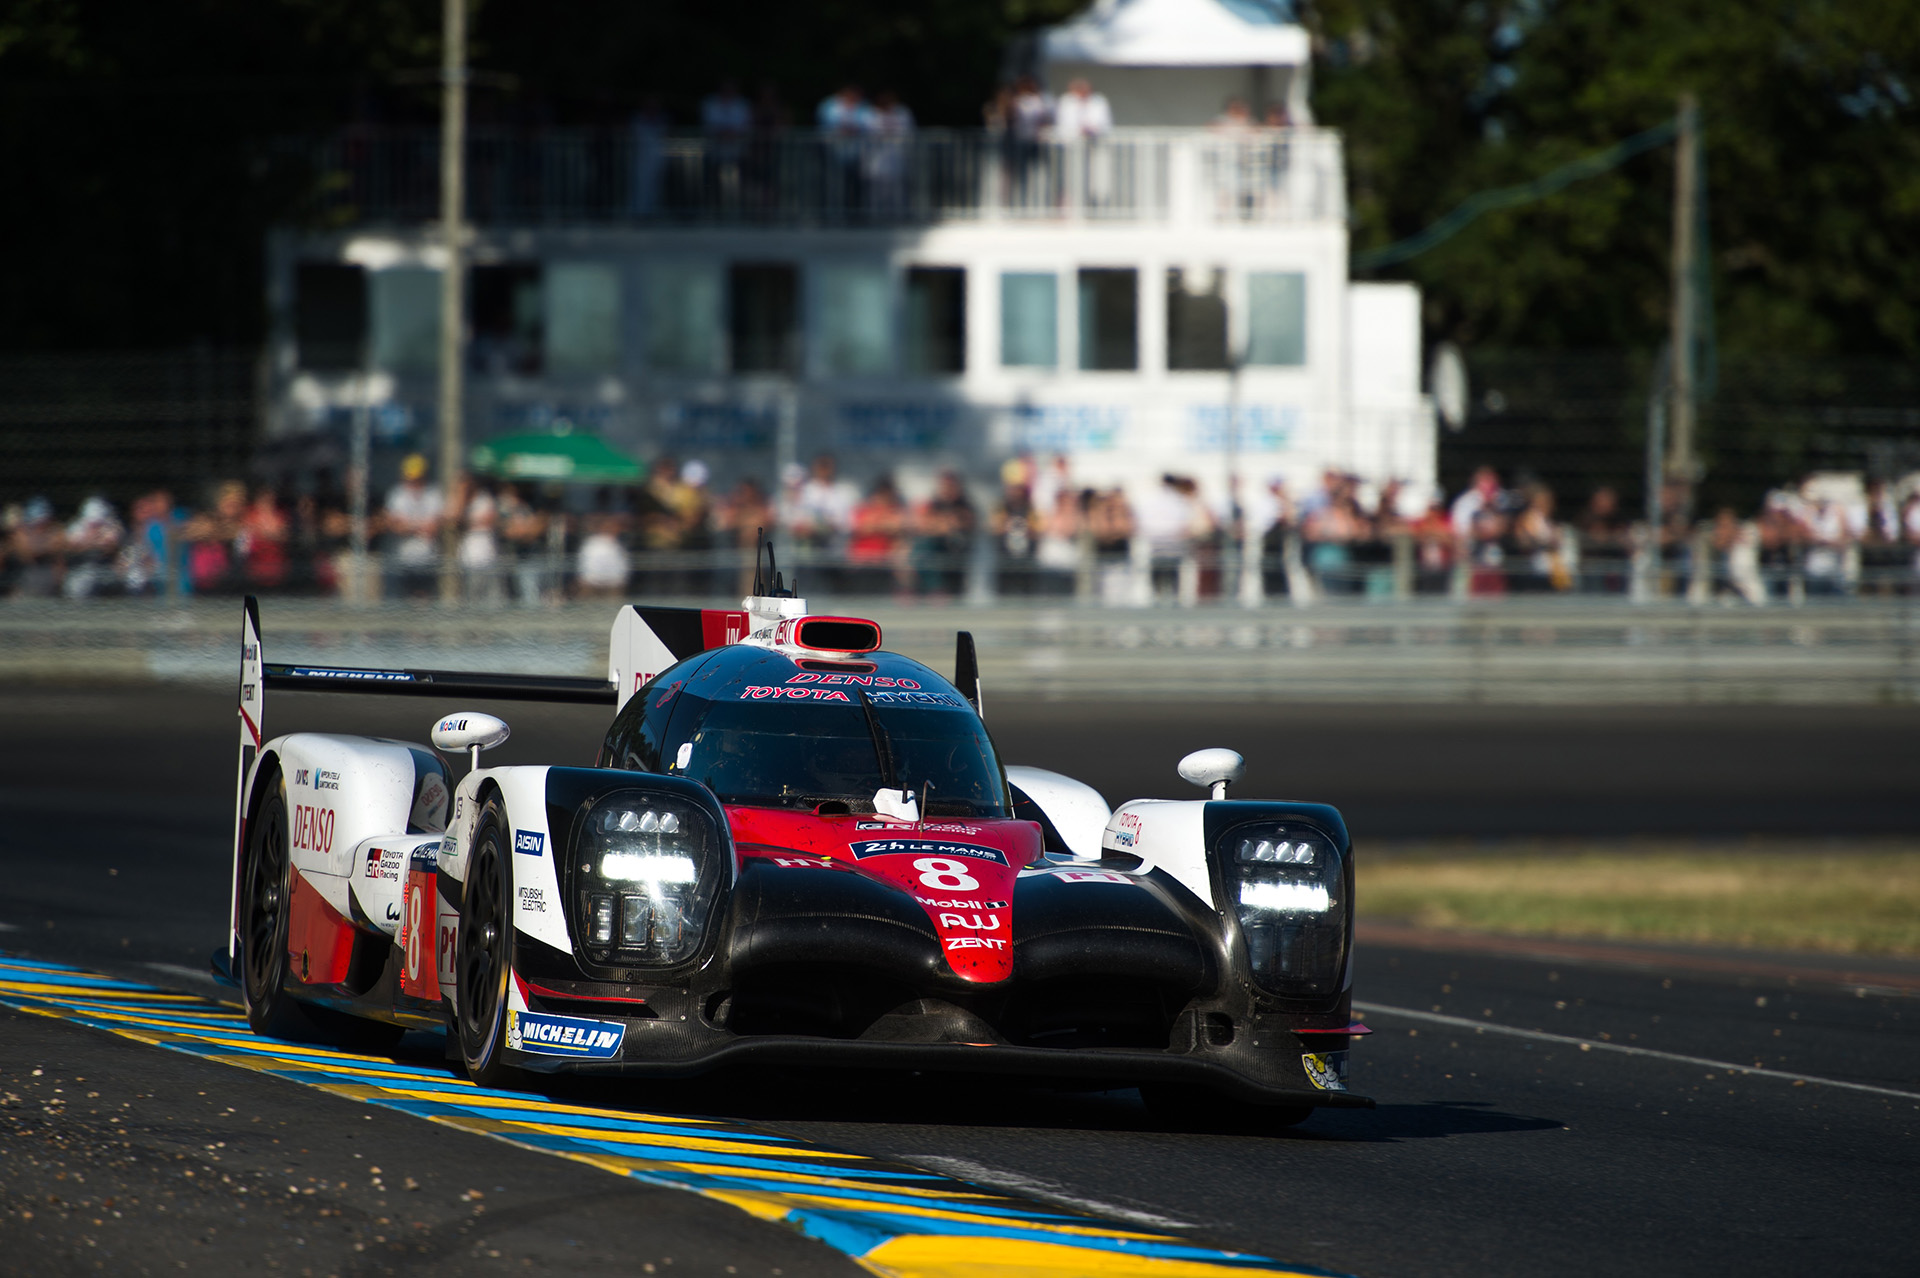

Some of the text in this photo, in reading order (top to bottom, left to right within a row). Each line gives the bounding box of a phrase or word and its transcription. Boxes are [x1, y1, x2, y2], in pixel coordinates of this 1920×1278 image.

[308, 671, 411, 681] MICHELIN
[785, 673, 922, 690] DENSO
[740, 685, 963, 708] TOYOTA HYBRID
[439, 719, 458, 732] Mobil
[293, 804, 335, 854] DENSO
[1119, 812, 1142, 845] TOYOTA 8
[516, 834, 542, 852] AISIN
[1115, 830, 1134, 848] HYBRID
[382, 850, 404, 860] TOYOTA
[939, 845, 997, 858] MANS
[366, 860, 379, 878] GR
[380, 860, 399, 869] GAZOO
[774, 858, 834, 868] HY
[380, 870, 399, 882] Racing
[912, 857, 980, 891] 8
[522, 899, 547, 912] ELECTRIC
[915, 896, 983, 909] Mobil
[408, 886, 421, 981] 8
[440, 926, 457, 973] P1
[945, 937, 1006, 950] ZENT
[523, 1021, 620, 1048] MICHELIN
